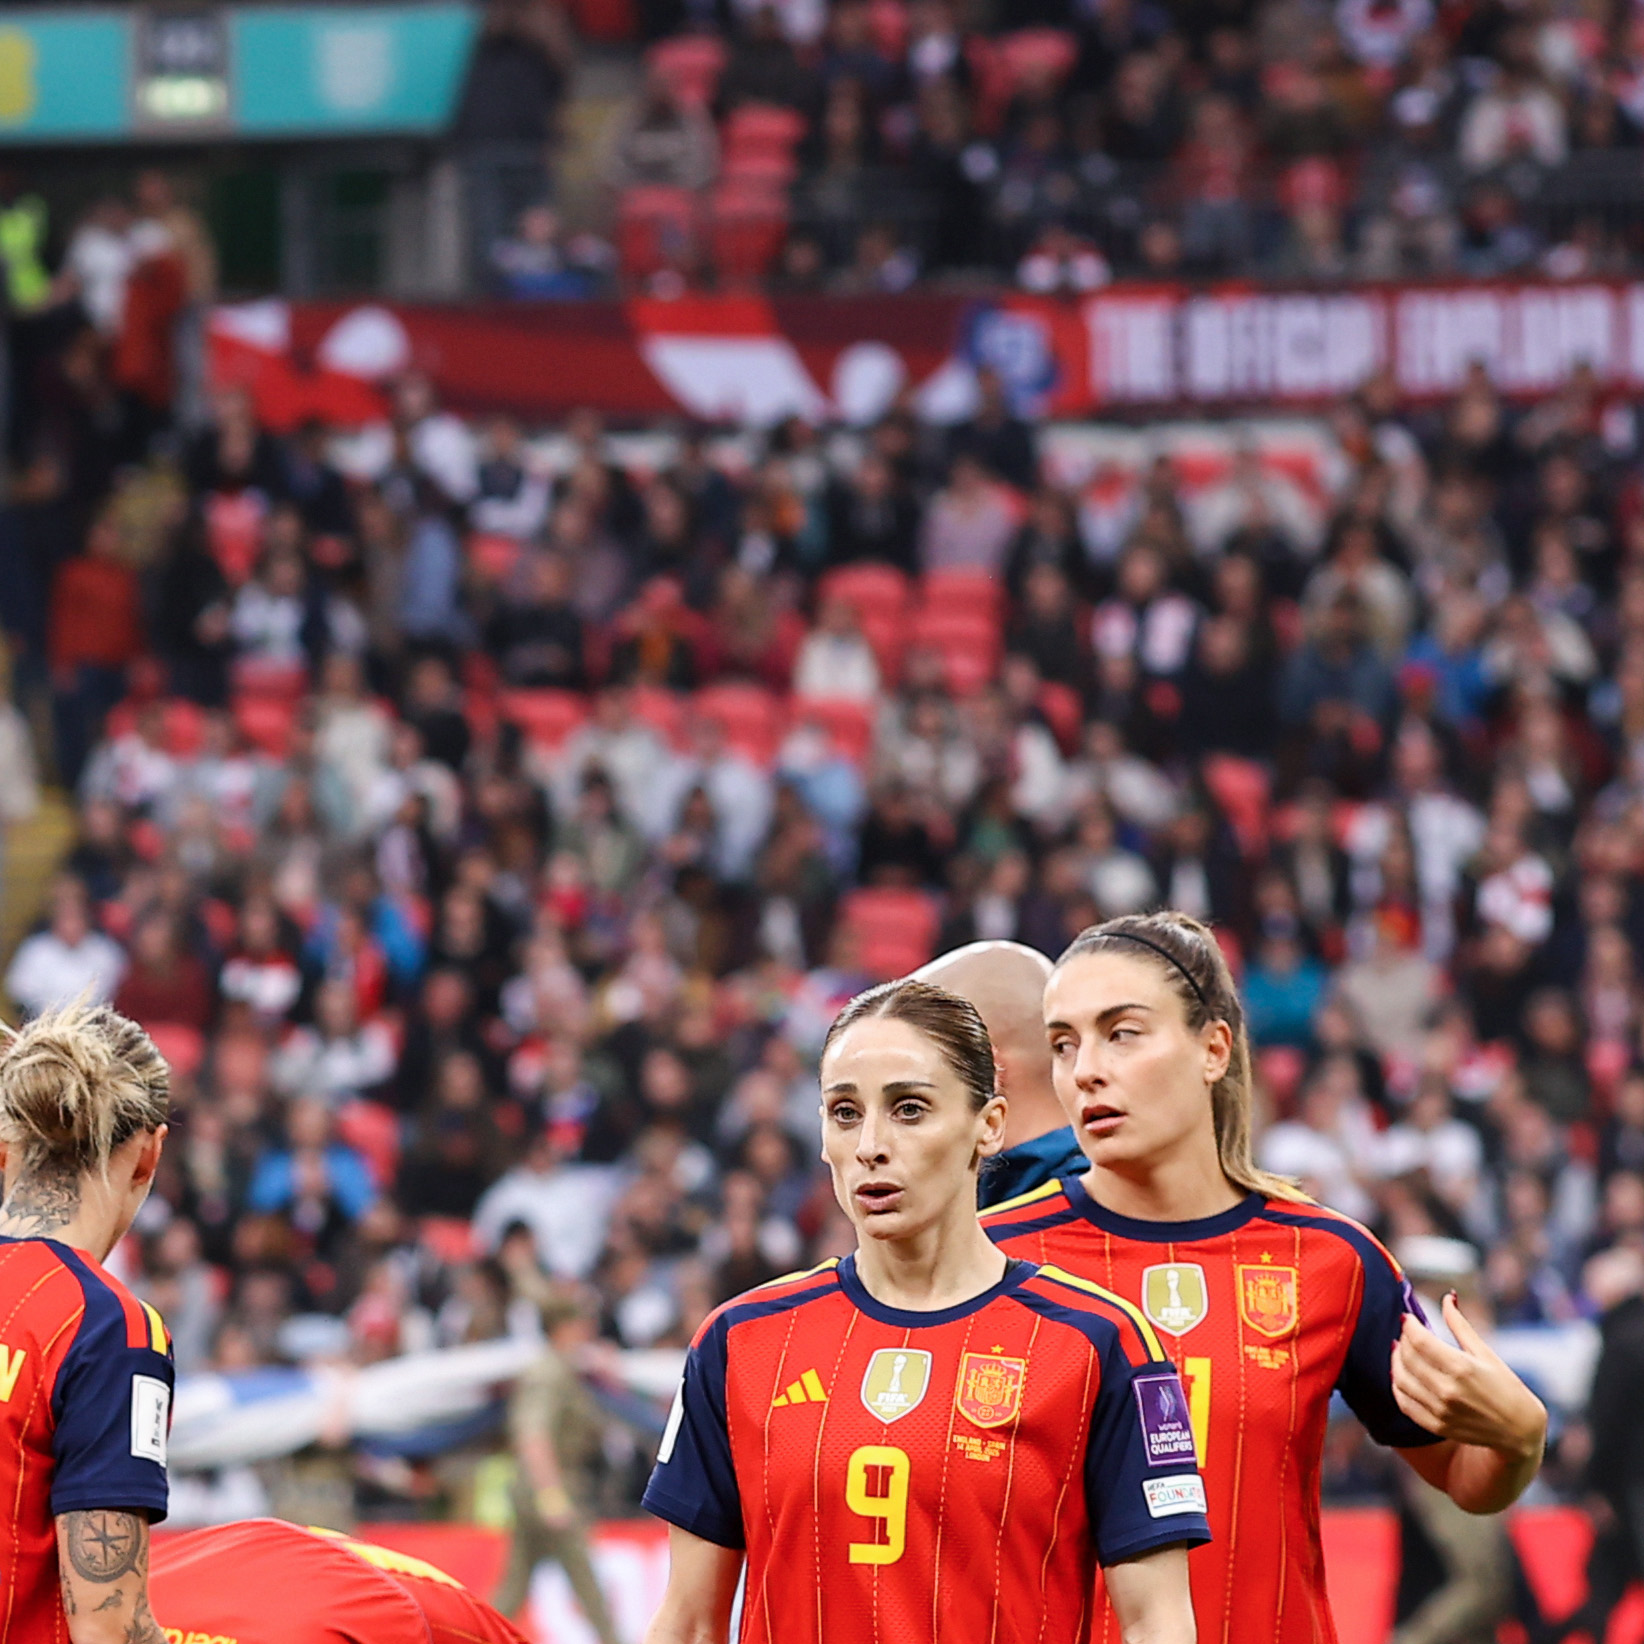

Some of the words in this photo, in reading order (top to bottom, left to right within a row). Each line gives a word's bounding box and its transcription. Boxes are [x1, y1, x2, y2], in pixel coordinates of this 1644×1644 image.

[1149, 1430, 1191, 1443] EUROPEAN
[1150, 1440, 1194, 1456] QUALIFIERS
[846, 1446, 910, 1565] 9
